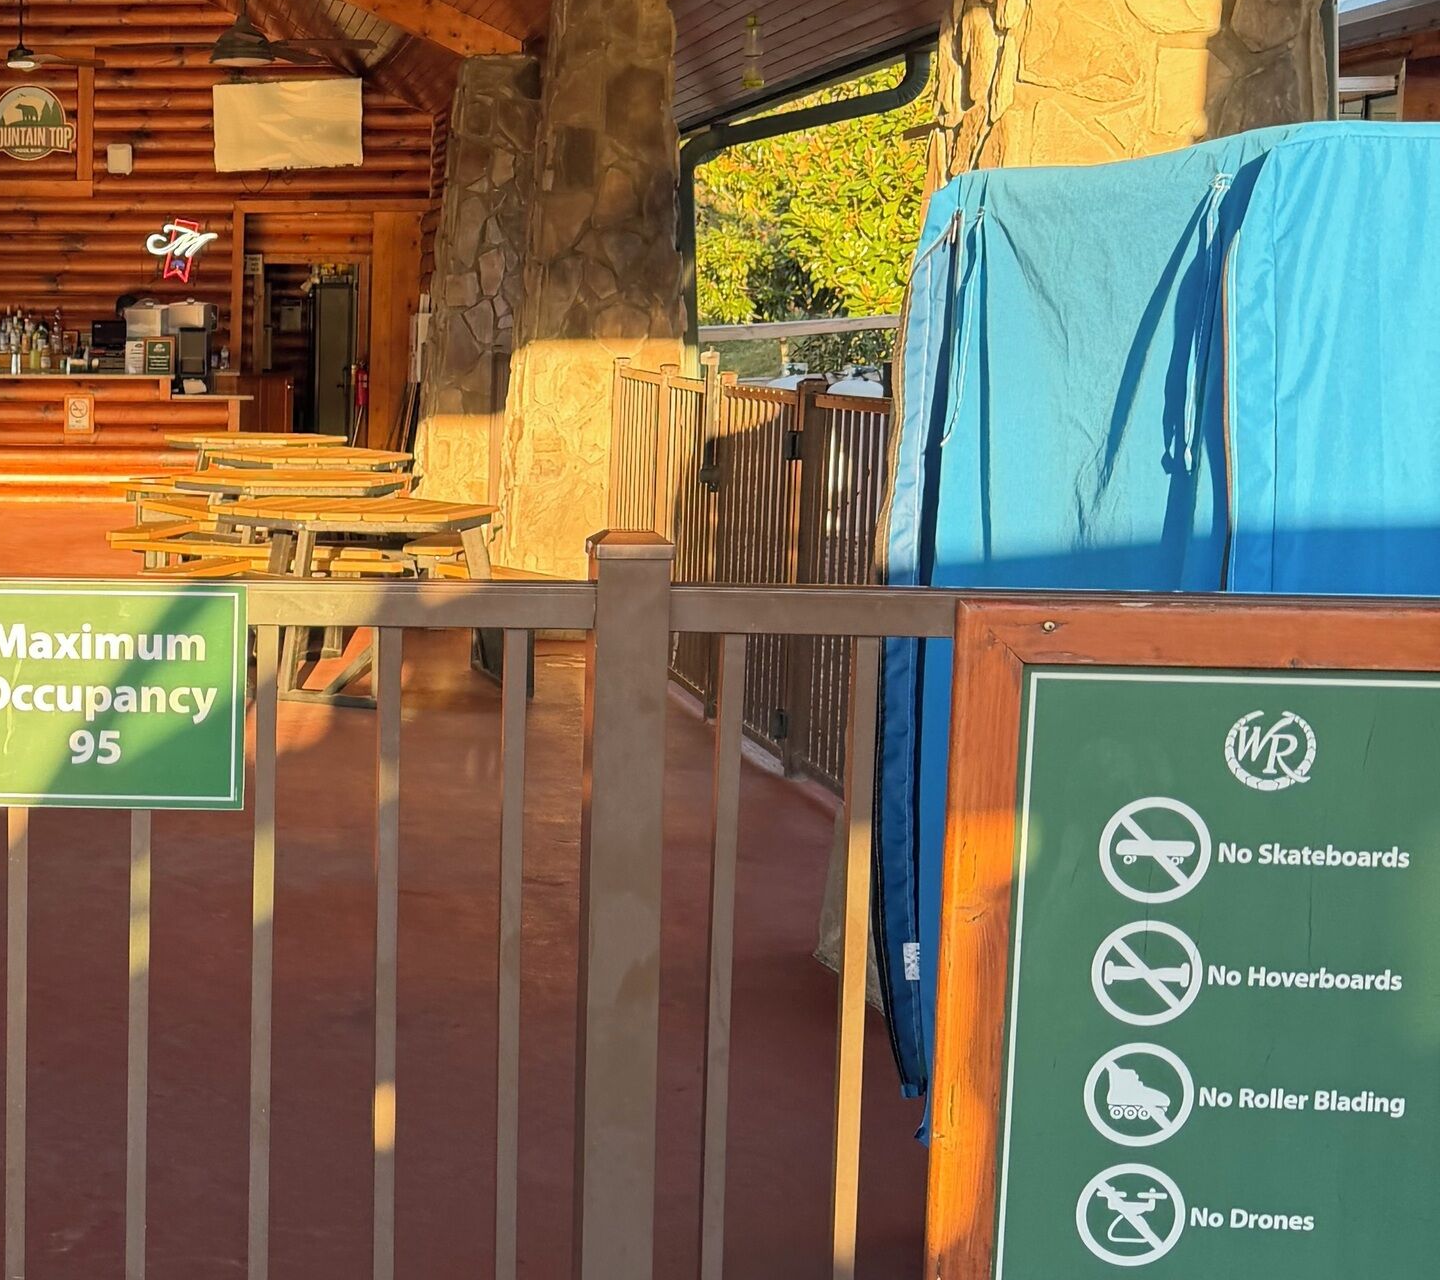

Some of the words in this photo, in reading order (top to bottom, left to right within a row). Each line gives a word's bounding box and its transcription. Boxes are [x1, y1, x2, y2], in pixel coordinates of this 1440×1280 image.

[49, 127, 73, 148] TOP
[68, 729, 122, 765] 95
[1218, 842, 1253, 865] No
[1257, 842, 1411, 869] Skateboards
[1207, 964, 1242, 987] No
[1247, 966, 1404, 991] Hoverboards
[1198, 1086, 1233, 1108] No
[1238, 1087, 1309, 1111] Roller
[1313, 1089, 1406, 1119] Blading
[1190, 1207, 1224, 1228] No
[1229, 1208, 1315, 1231] Drones
